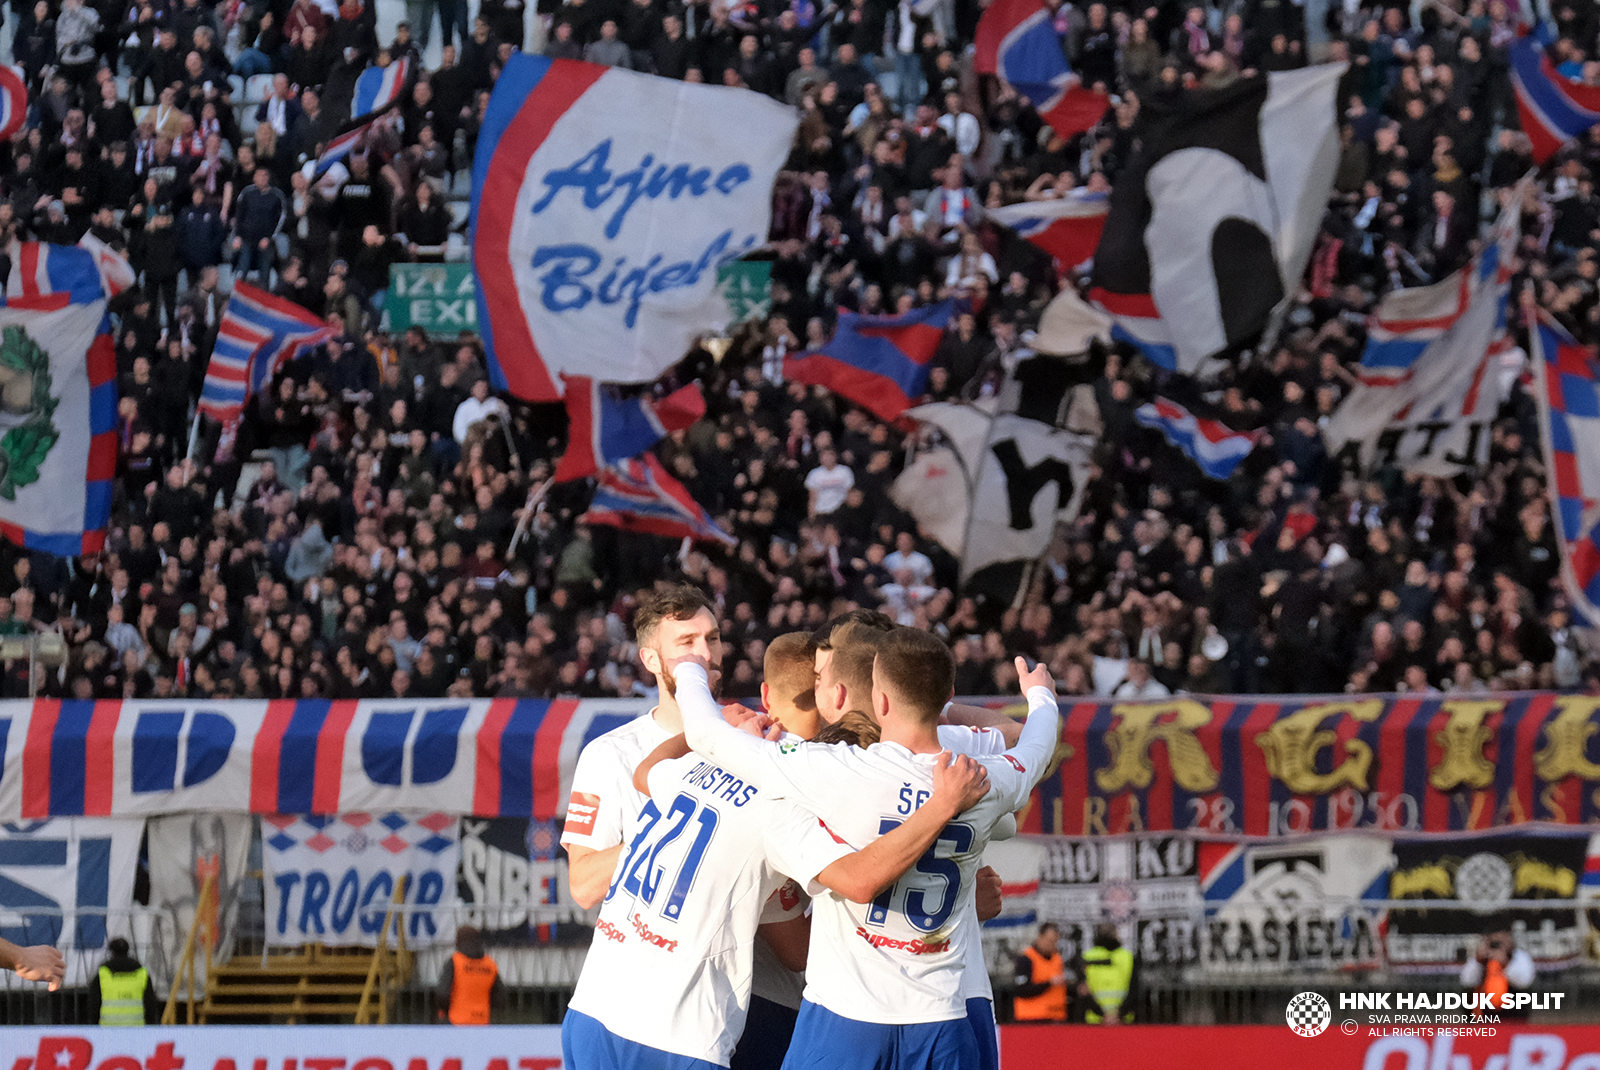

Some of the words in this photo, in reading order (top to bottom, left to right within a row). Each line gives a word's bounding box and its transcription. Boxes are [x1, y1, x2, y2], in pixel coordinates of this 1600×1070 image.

[531, 137, 752, 240] Ajmo
[409, 298, 477, 325] EXI
[898, 782, 930, 815] ŠE
